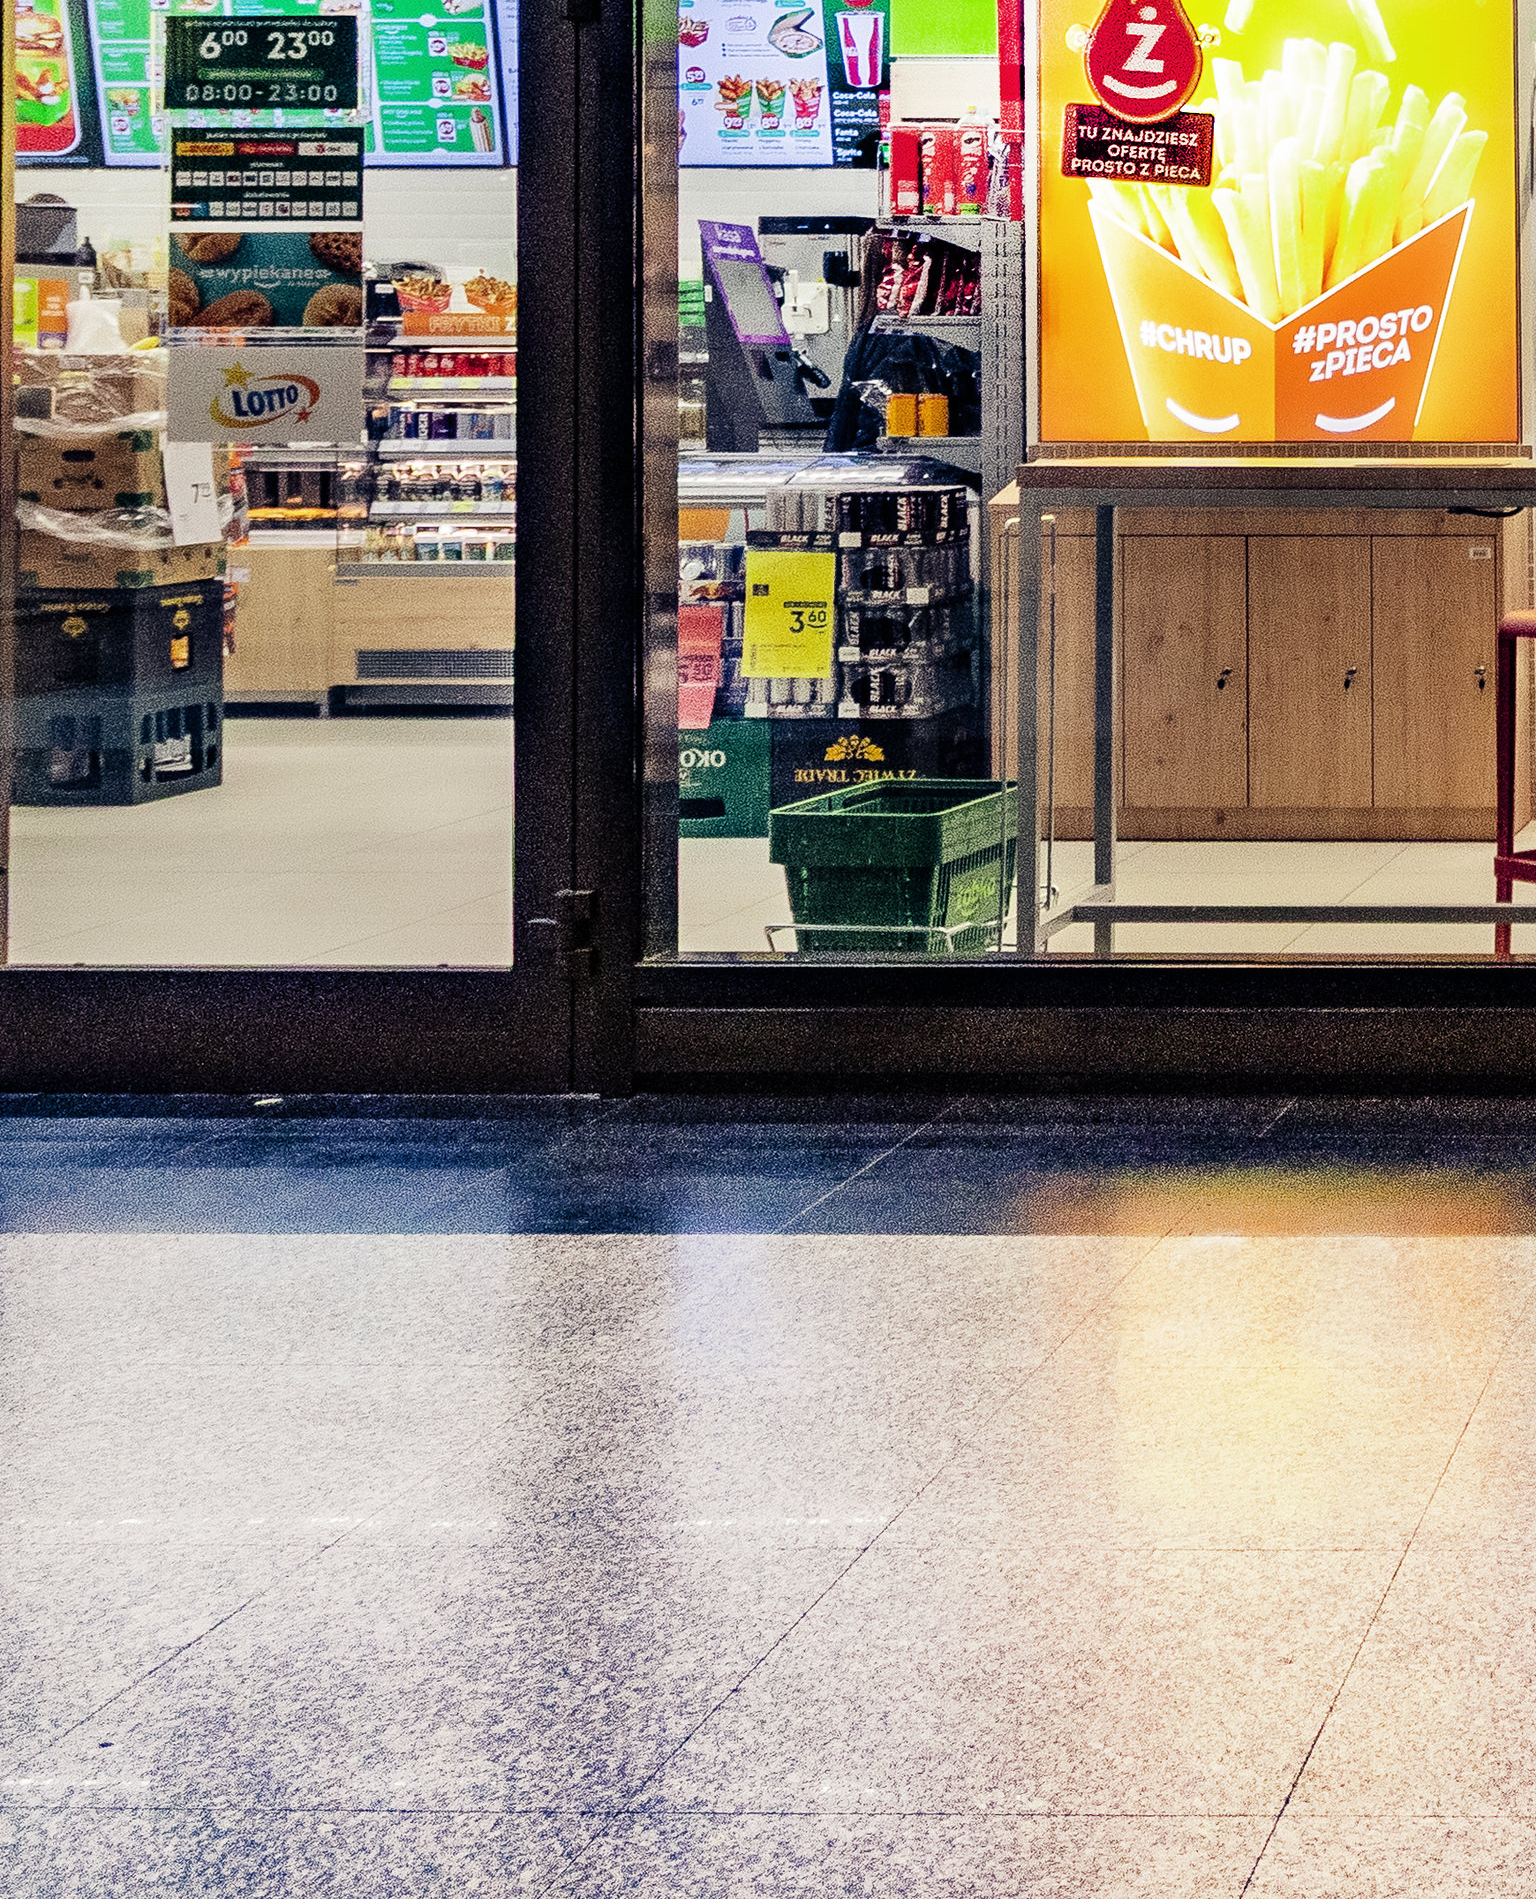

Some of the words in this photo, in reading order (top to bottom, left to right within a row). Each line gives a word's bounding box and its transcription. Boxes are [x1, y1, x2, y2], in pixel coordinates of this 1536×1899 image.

[833, 91, 876, 100] Coca-Cola
[834, 109, 878, 118] Coca-Cola
[835, 128, 859, 137] Fanta
[1077, 125, 1098, 141] TU
[1101, 126, 1198, 149] ZNAJDZIESZ
[836, 148, 862, 158] Sprite
[1107, 144, 1167, 163] OFERTĘ
[1071, 158, 1137, 176] PROSTO
[1140, 161, 1151, 177] Z
[1154, 163, 1201, 181] PIECA
[1293, 304, 1434, 355] #PROSTO
[1139, 319, 1252, 366] #CHRUP
[1309, 337, 1413, 383] zPIECA
[232, 383, 299, 418] LOTTO
[780, 534, 809, 544] BLACK
[870, 534, 899, 544] BLACK
